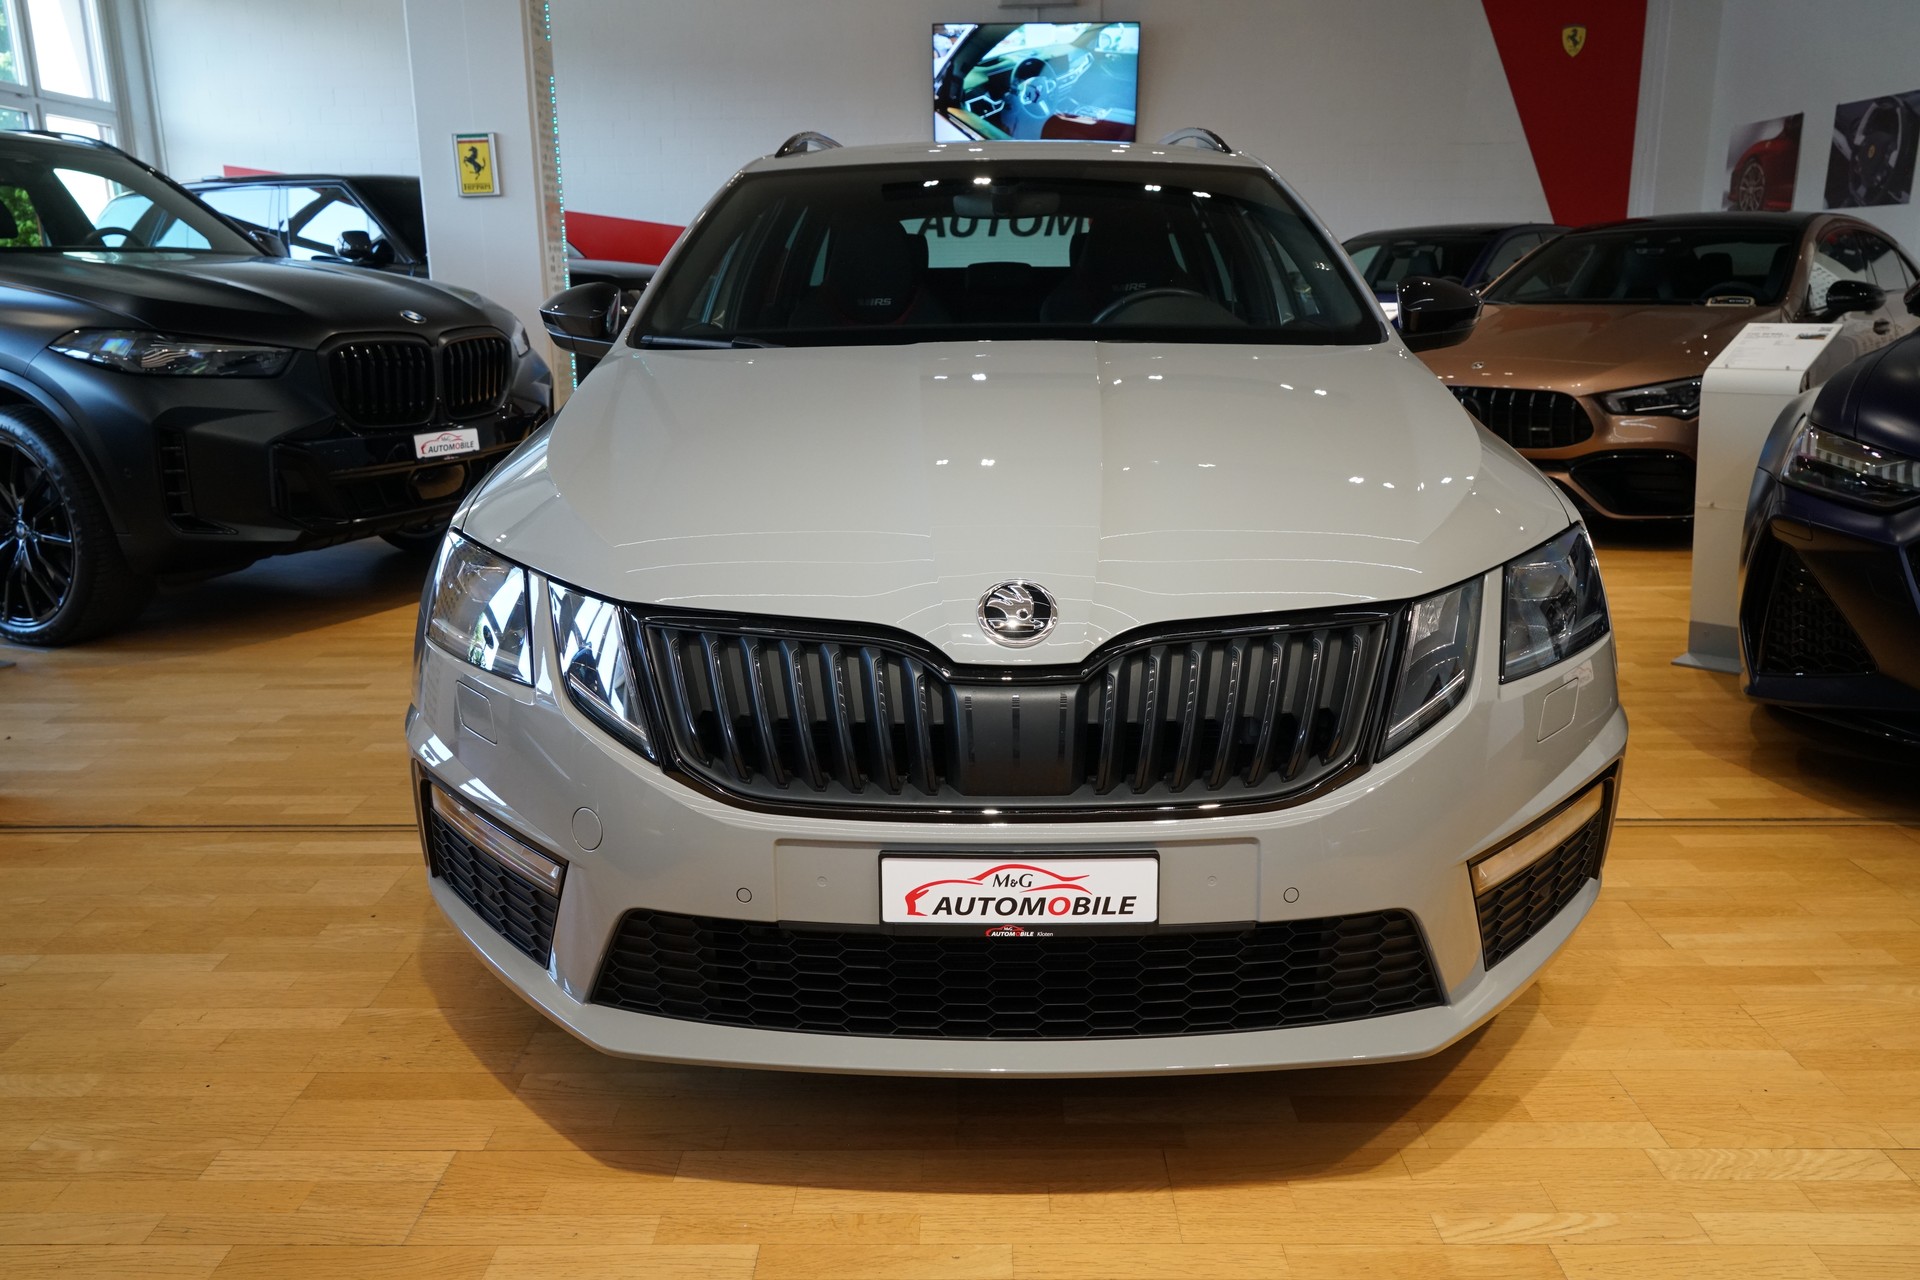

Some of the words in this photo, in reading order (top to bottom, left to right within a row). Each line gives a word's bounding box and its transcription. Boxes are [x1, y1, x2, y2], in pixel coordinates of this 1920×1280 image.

[917, 215, 1093, 238] AUTOM
[428, 441, 474, 453] AUTOMOBILE
[992, 873, 1034, 888] M&G
[932, 895, 1137, 916] AUTOMOBILE
